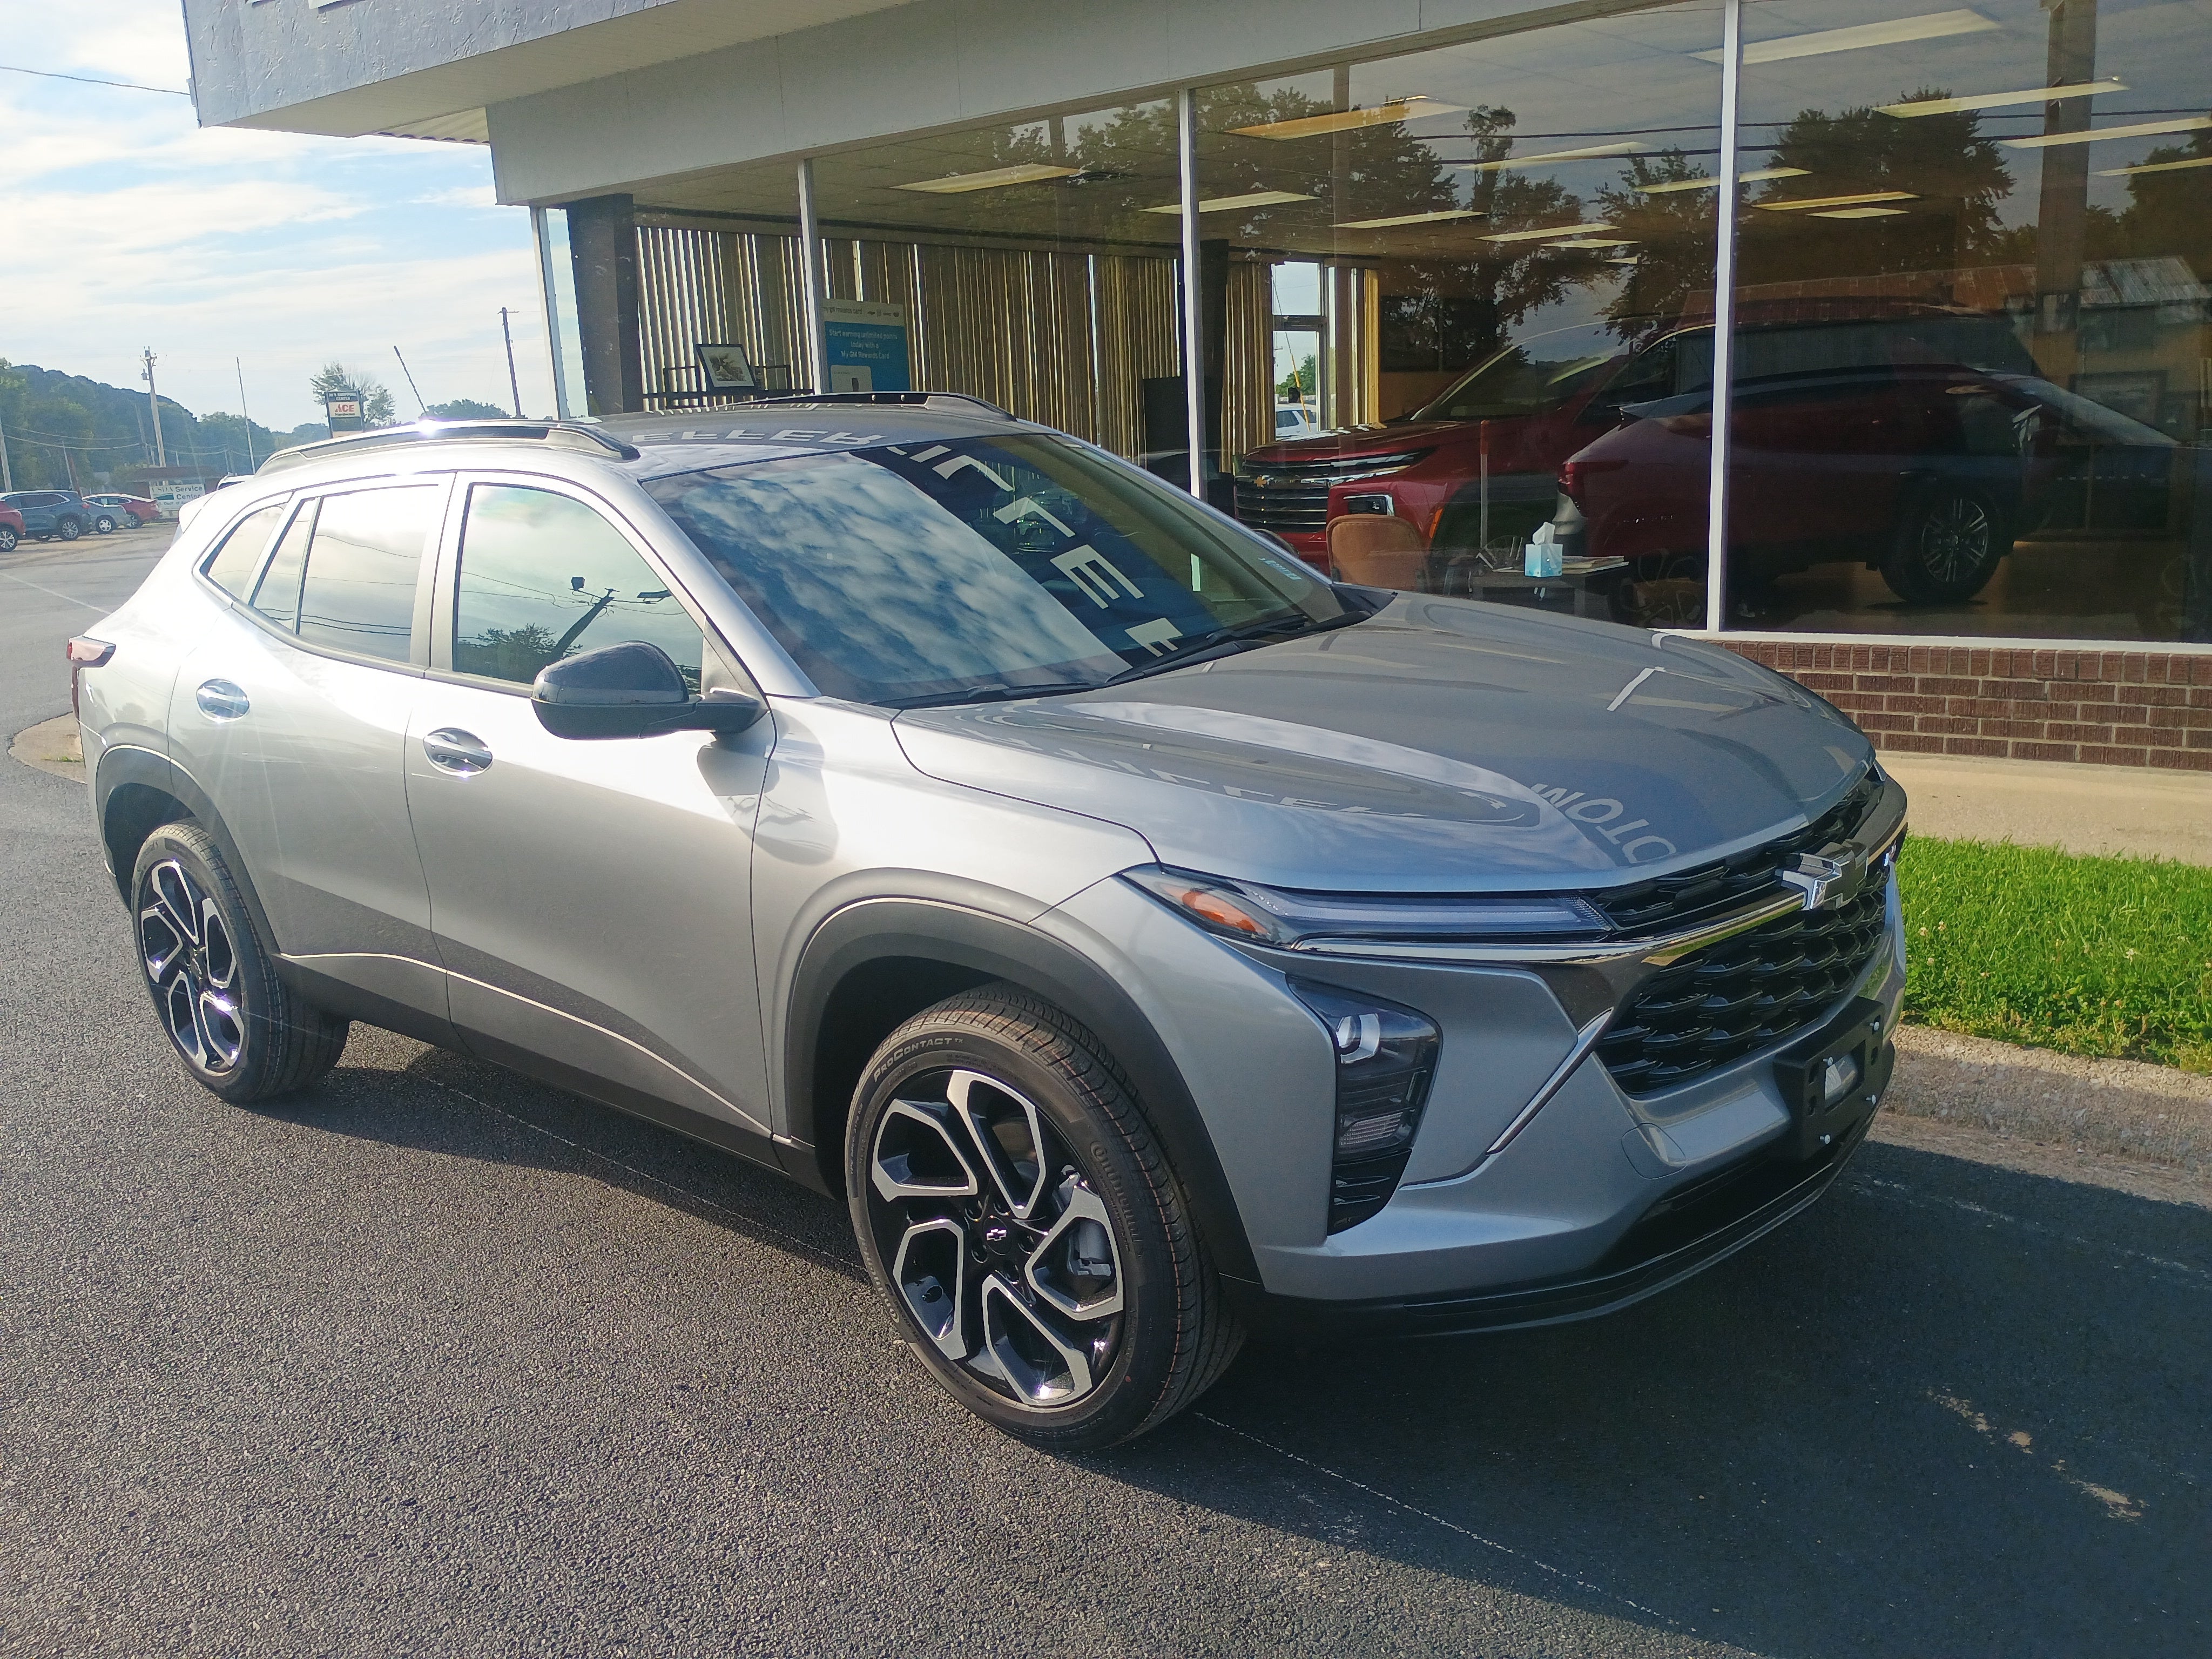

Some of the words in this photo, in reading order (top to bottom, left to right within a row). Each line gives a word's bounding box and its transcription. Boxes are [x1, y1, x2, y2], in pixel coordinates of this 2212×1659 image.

[861, 331, 882, 339] unlimited
[851, 341, 864, 350] today
[335, 403, 355, 413] ACE
